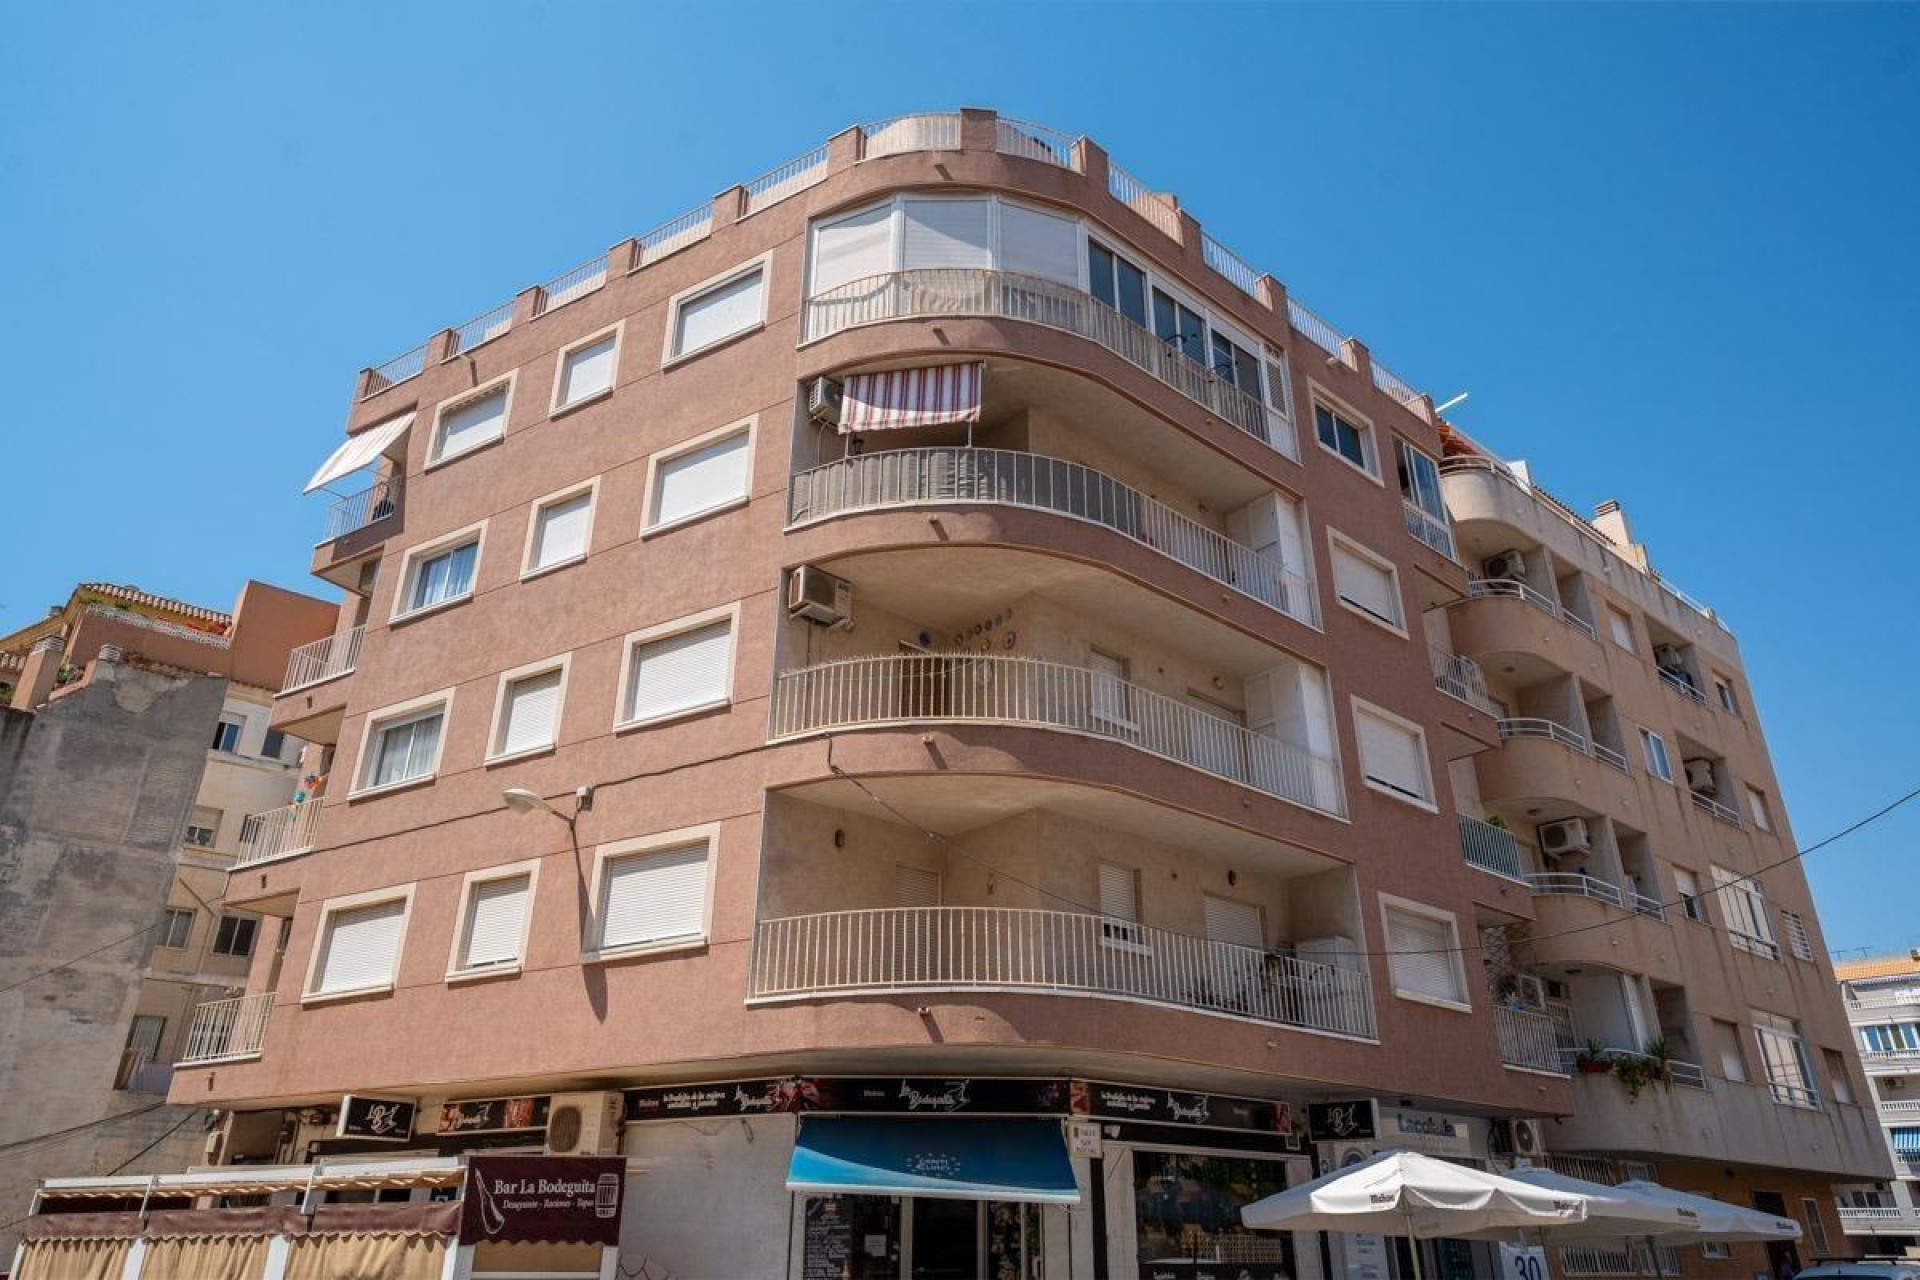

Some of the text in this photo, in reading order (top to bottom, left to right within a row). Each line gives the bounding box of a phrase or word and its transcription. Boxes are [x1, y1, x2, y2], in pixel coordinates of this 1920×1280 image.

[493, 1178, 596, 1198] Bar La Bodeguita
[1514, 1255, 1543, 1280] 30
